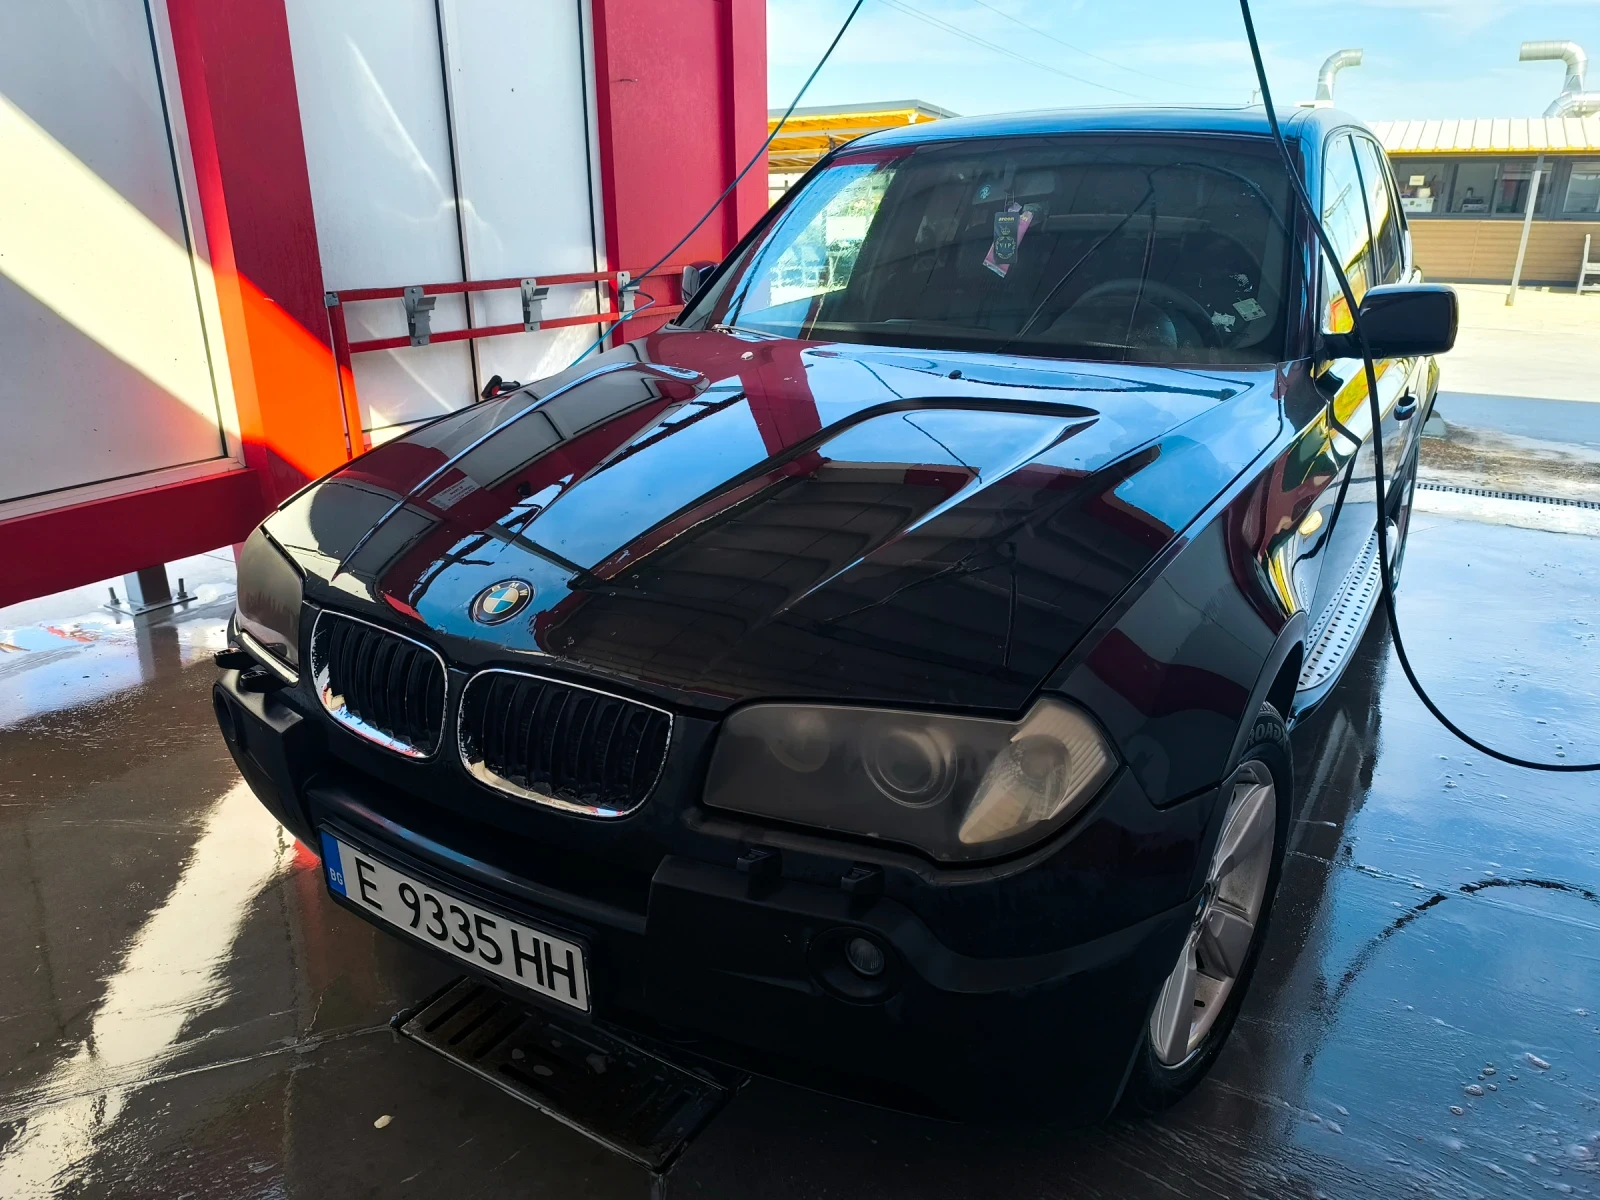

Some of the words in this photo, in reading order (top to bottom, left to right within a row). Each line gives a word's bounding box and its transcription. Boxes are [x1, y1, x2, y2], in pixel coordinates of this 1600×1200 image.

[491, 582, 529, 596] BMW
[329, 868, 344, 886] BG
[355, 856, 382, 911] E
[398, 882, 503, 965] 9335
[511, 928, 578, 1000] HH
